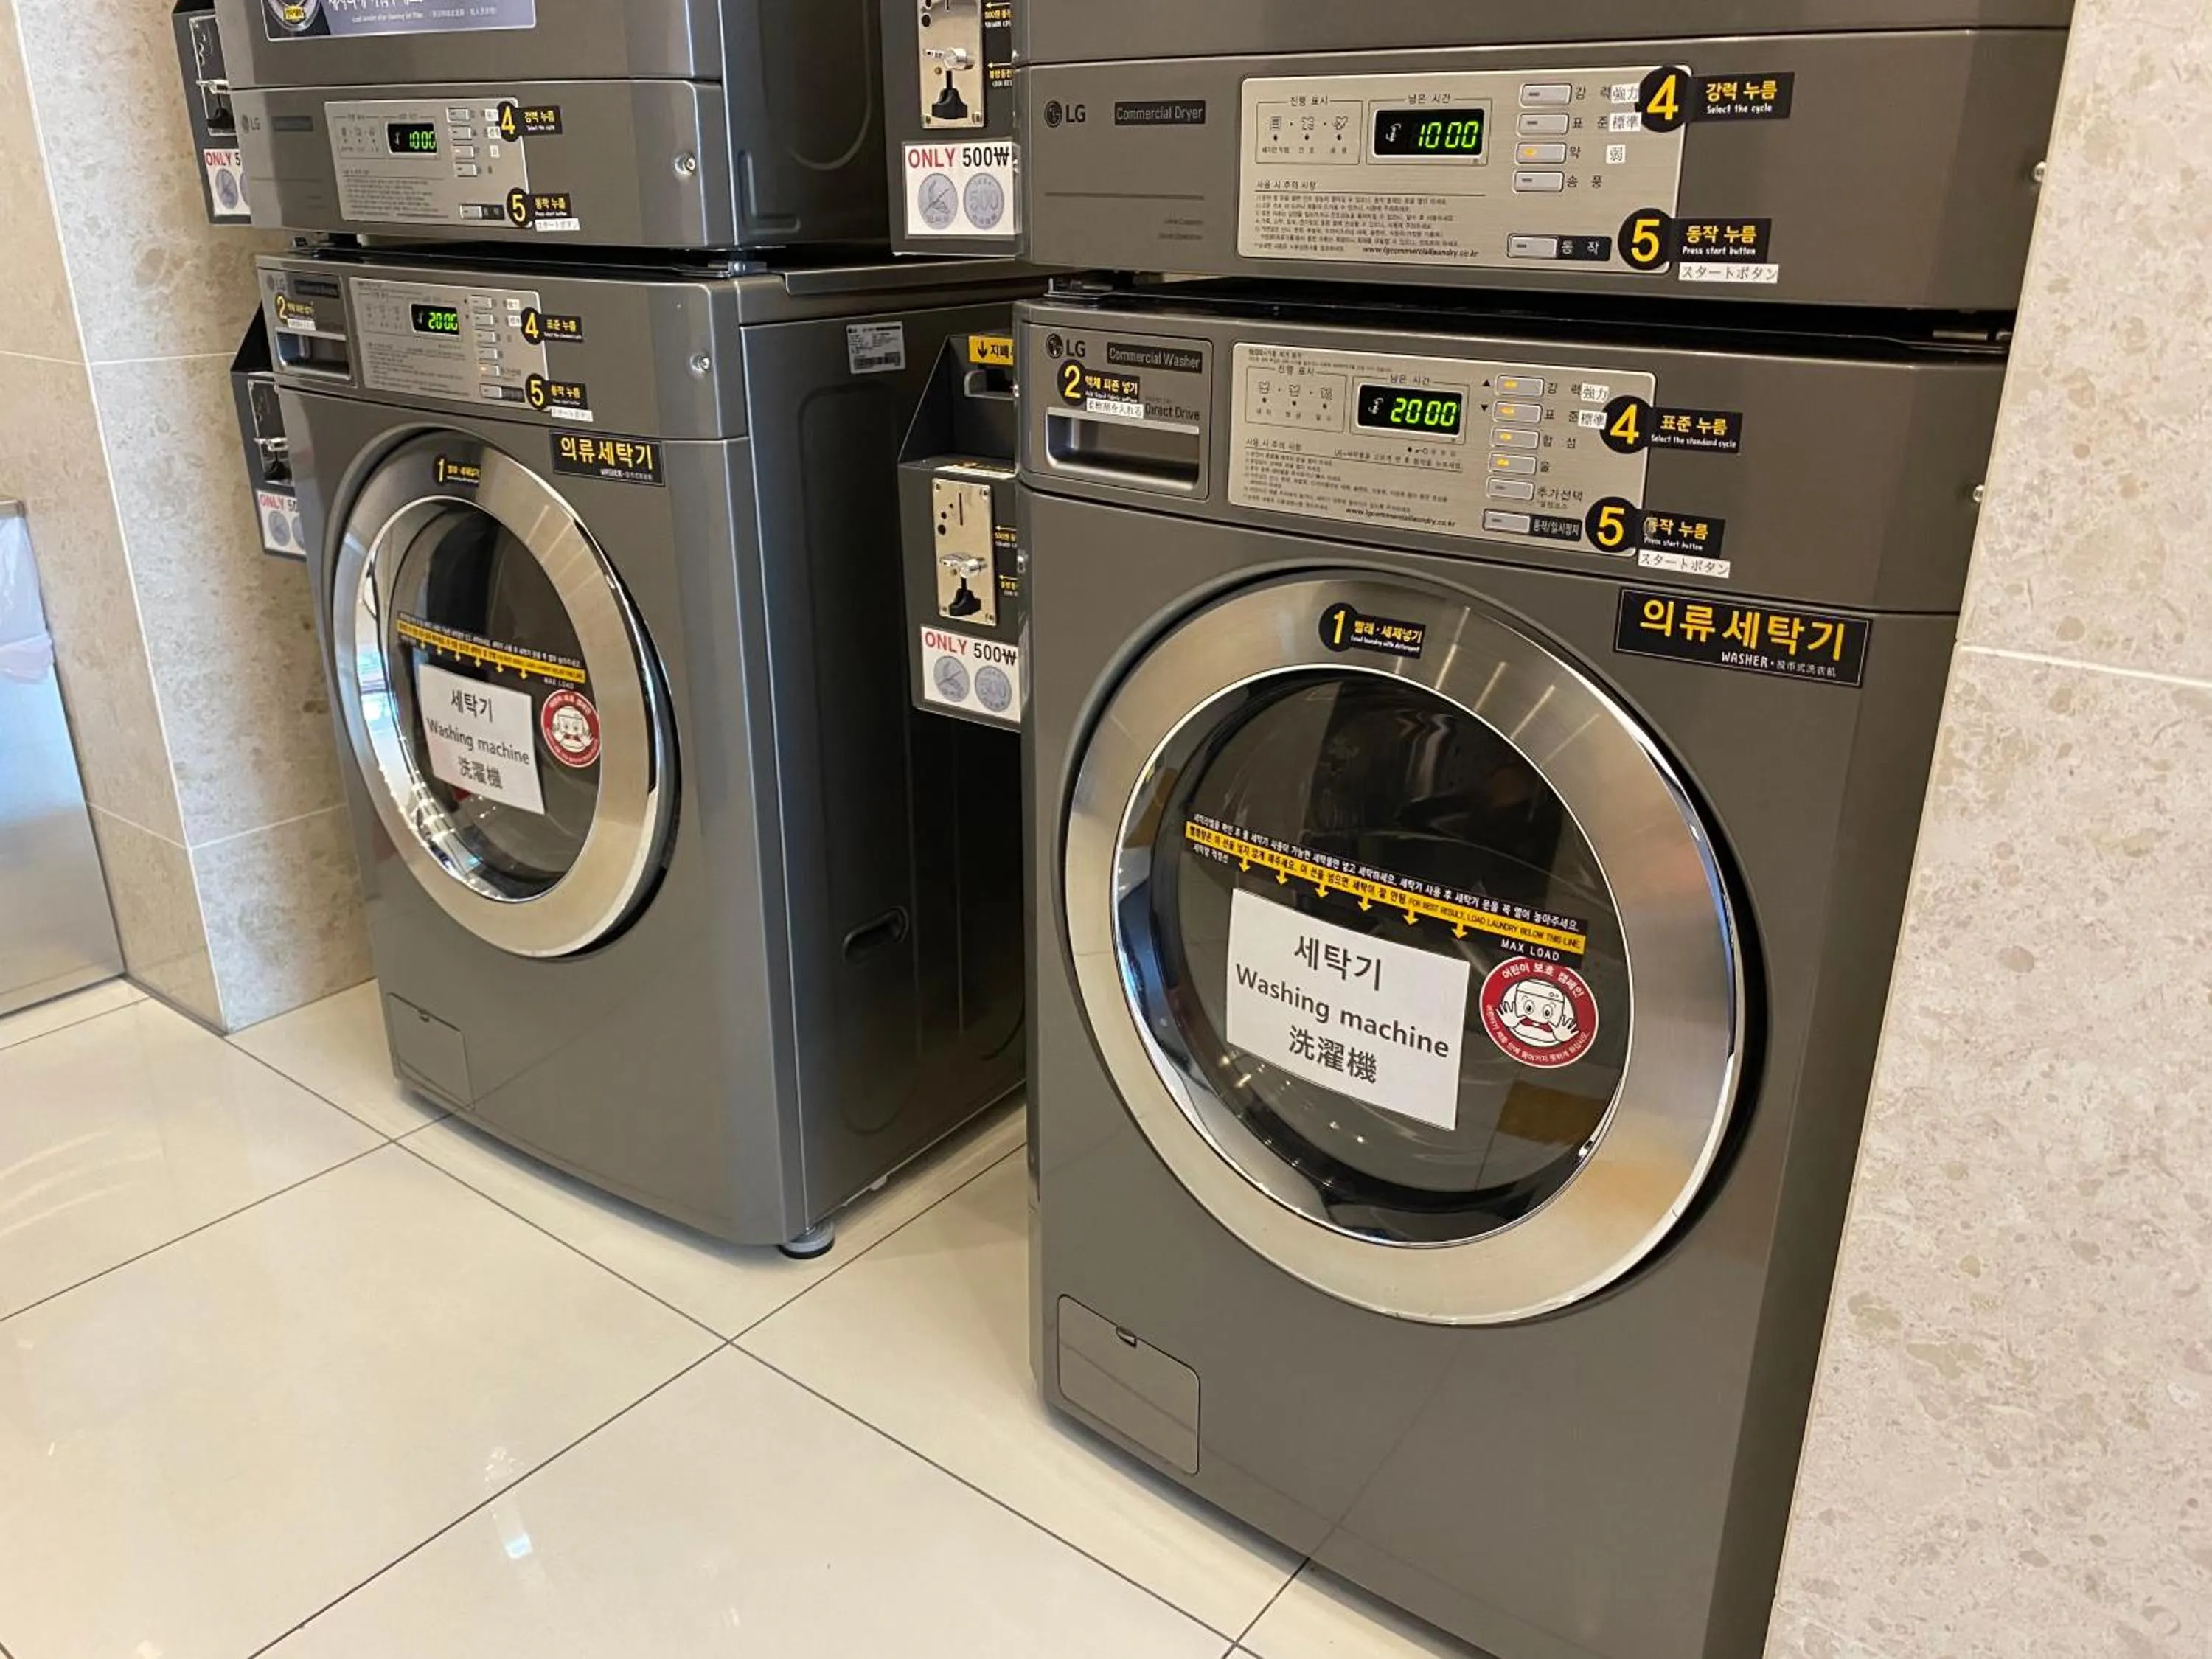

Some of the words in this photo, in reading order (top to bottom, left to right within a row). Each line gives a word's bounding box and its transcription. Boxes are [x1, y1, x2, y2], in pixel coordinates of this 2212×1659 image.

[1408, 94, 1426, 105] 남은
[1433, 94, 1450, 104] 시간
[1647, 74, 1678, 120] 4
[1705, 83, 1736, 102] 강력
[1745, 80, 1777, 100] 누름
[1066, 104, 1086, 124] LG
[1116, 105, 1172, 122] Commercial
[1175, 105, 1203, 123] Dryer
[1707, 103, 1731, 114] Select
[1734, 103, 1748, 114] the
[1751, 102, 1772, 114] cycle
[250, 117, 260, 130] LG
[501, 105, 515, 135] 4
[1573, 116, 1584, 129] 표
[204, 153, 232, 166] ONLY
[908, 148, 956, 169] ONLY
[512, 194, 526, 222] 5
[1632, 218, 1660, 262] 5
[1686, 226, 1719, 244] 동작
[1724, 225, 1756, 244] 누름
[1683, 246, 1703, 256] Press
[1705, 246, 1726, 256] start
[1729, 246, 1756, 256] button
[1682, 265, 1778, 280] スタートボタン
[276, 296, 288, 319] 2
[524, 313, 540, 338] 4
[1066, 340, 1086, 358] LG
[1110, 349, 1162, 364] Commercial
[1164, 352, 1200, 369] Washer
[531, 380, 543, 406] 5
[1065, 365, 1081, 399] 2
[1145, 403, 1172, 417] Direct
[1175, 406, 1200, 421] Drive
[1610, 403, 1640, 445] 4
[1660, 415, 1691, 433] 표준
[1697, 418, 1728, 437] 누름
[1651, 434, 1671, 444] Select
[1673, 435, 1685, 445] the
[1686, 437, 1717, 448] standard
[1718, 439, 1736, 449] cycle
[438, 458, 445, 482] 1
[260, 494, 284, 510] ONLY
[1537, 487, 1582, 502] 추가선택
[1597, 507, 1624, 546] 5
[1678, 521, 1708, 540] 누름
[1663, 538, 1680, 549] start
[1681, 540, 1703, 551] button
[1640, 553, 1729, 575] スタートボタン
[1334, 610, 1346, 644] 1
[1640, 599, 1845, 661] 의류세탁기
[925, 631, 967, 655] ONLY
[451, 689, 493, 723] 세탁기
[427, 717, 473, 751] Washing
[478, 737, 530, 765] machine
[458, 755, 503, 790] 洗濯機
[1501, 938, 1524, 953] MAX
[1530, 946, 1559, 961] LOAD
[1294, 935, 1381, 991] 세탁기
[1533, 962, 1555, 977] 보호
[1235, 963, 1329, 1024] Washing
[1340, 1009, 1449, 1058] machine
[1289, 1024, 1377, 1084] 洗濯機
